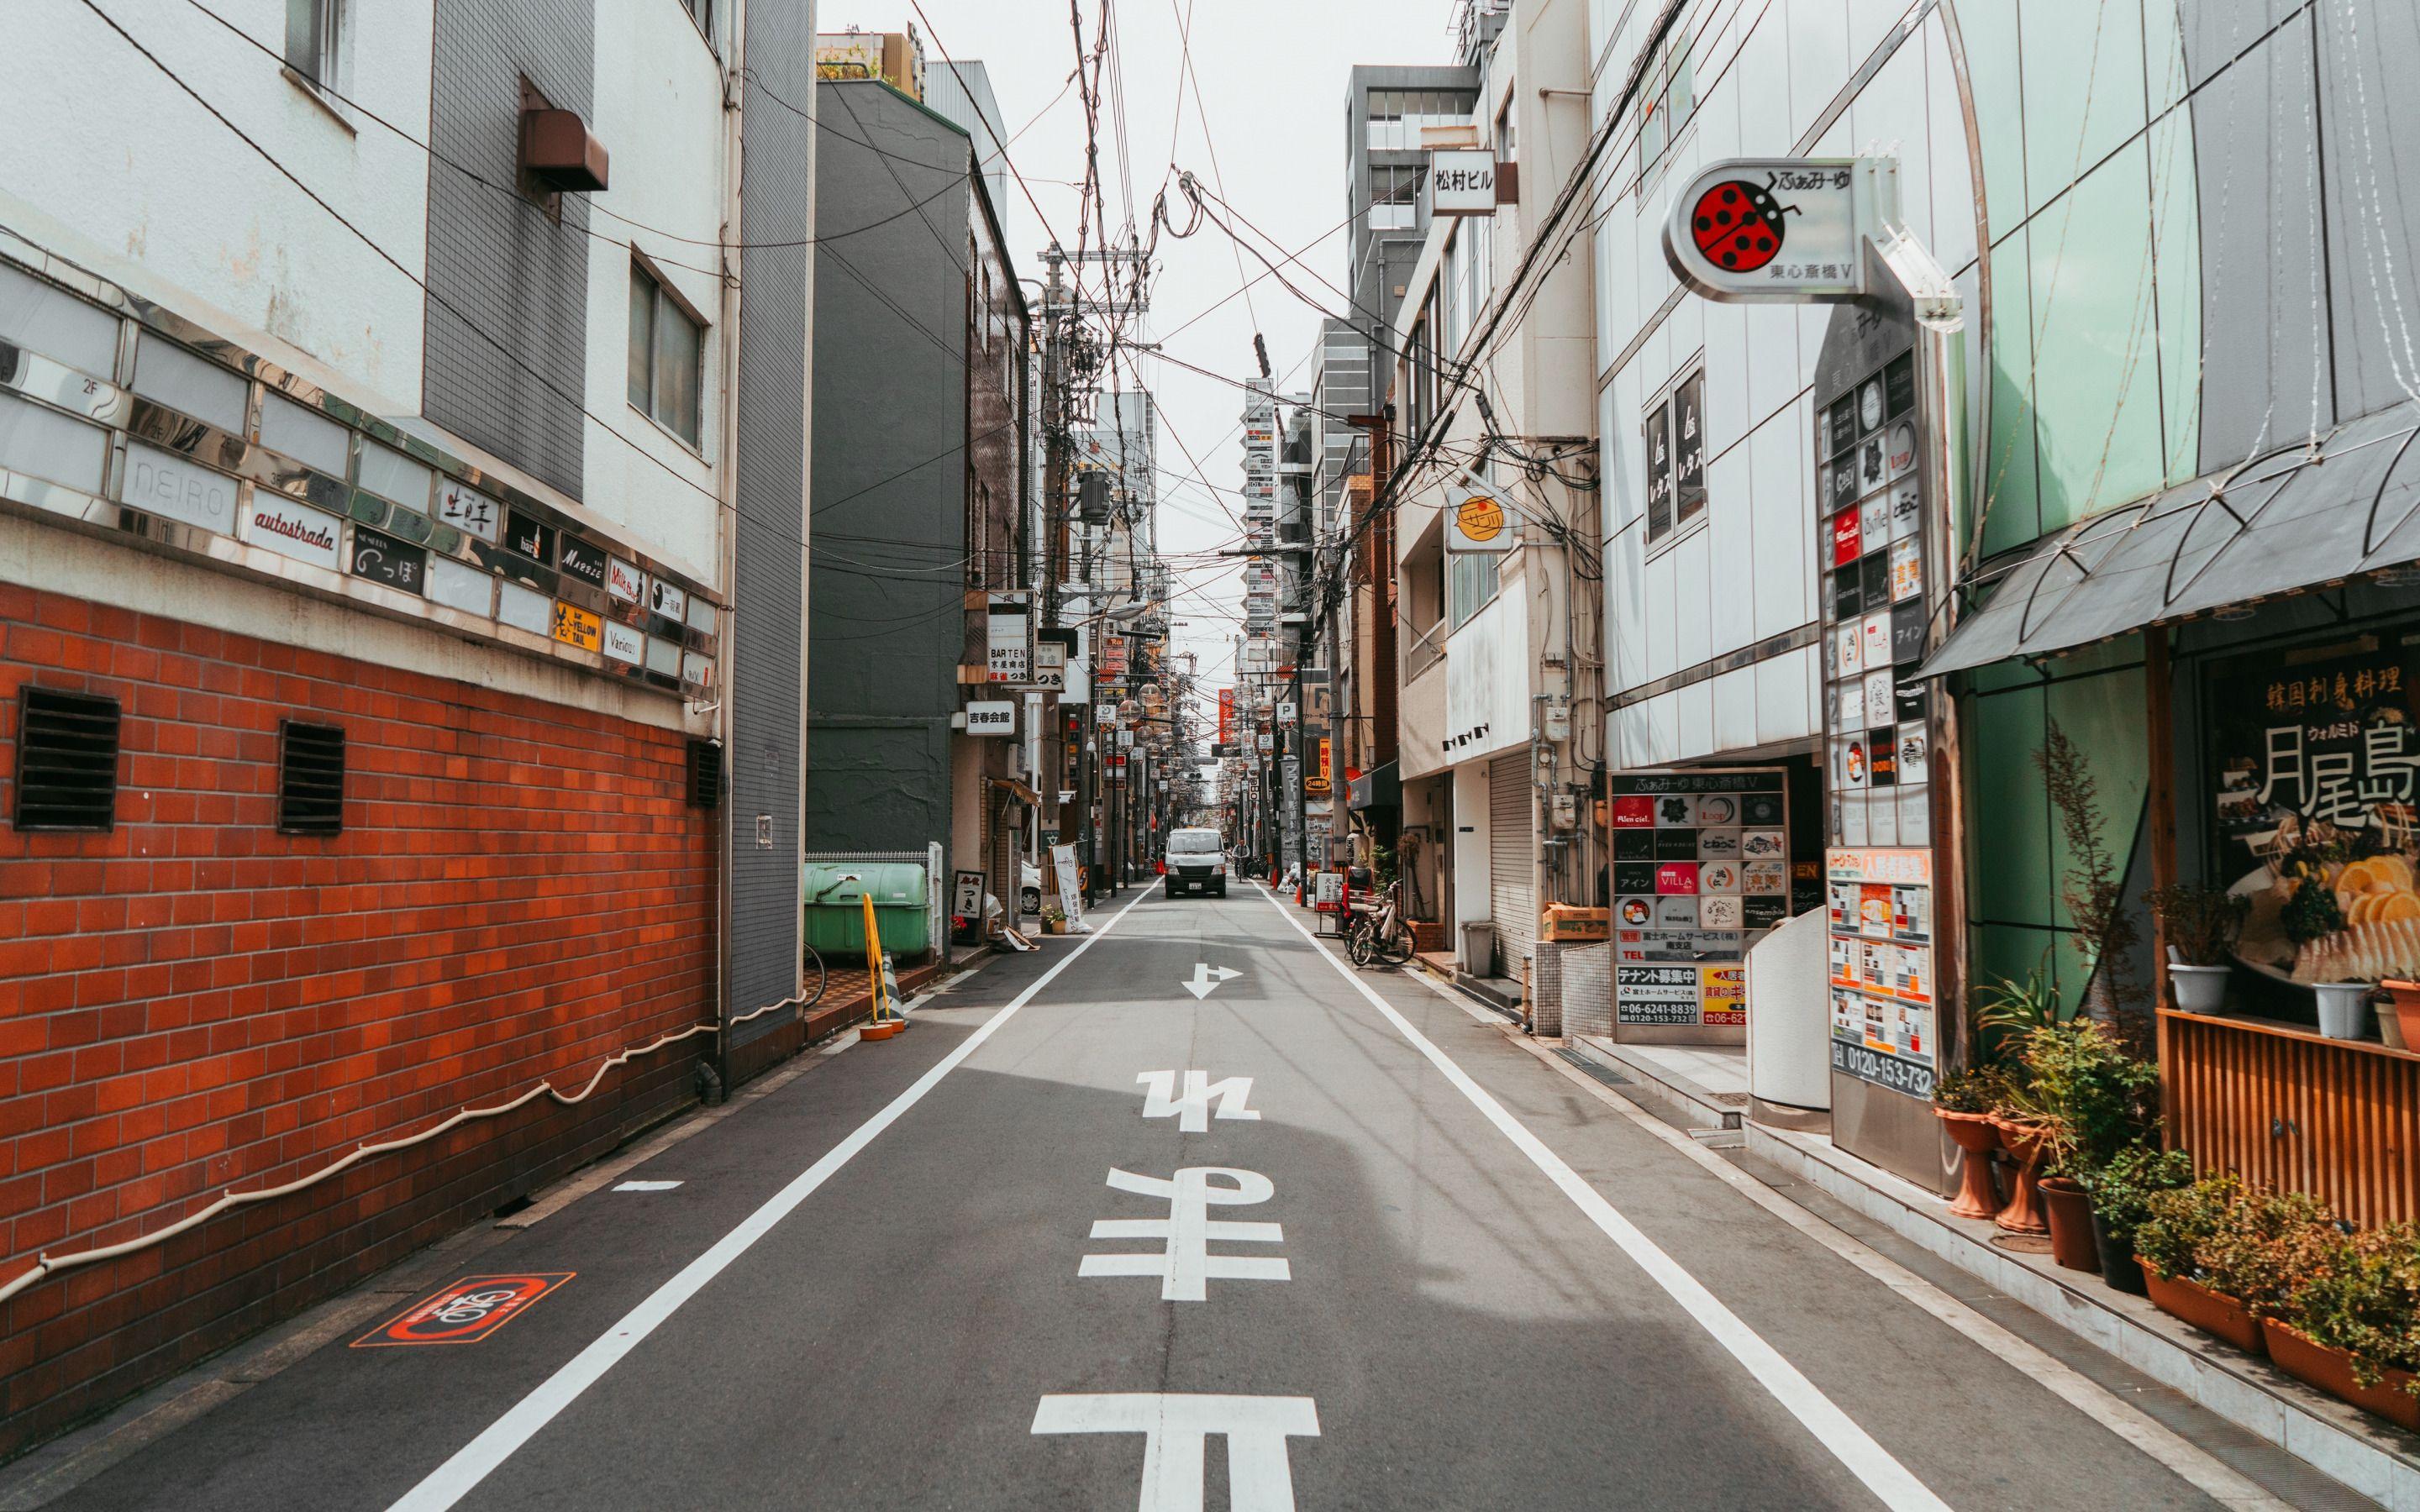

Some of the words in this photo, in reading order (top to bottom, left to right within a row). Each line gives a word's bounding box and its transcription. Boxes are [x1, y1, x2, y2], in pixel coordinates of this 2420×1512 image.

[1436, 170, 1493, 192] 松村ビル
[84, 379, 97, 395] 2F
[150, 426, 163, 439] 2F
[1679, 447, 1702, 480] レタス
[1650, 472, 1671, 503] レタス
[255, 511, 334, 551] autostrada
[573, 619, 597, 637] YELLOW
[572, 633, 586, 646] TAIL
[610, 630, 637, 655] Various
[992, 649, 1006, 658] BAR
[1008, 649, 1025, 658] TEN
[1038, 673, 1061, 685] つき
[2266, 666, 2403, 711] 韓国刺身料理
[1282, 706, 1291, 715] P
[970, 711, 1010, 724] 吉春会館
[2257, 720, 2420, 827] 月尾島
[1620, 879, 1649, 887] アイン
[1661, 877, 1692, 885] VILLA
[1643, 932, 1739, 942] 富士ホームサービス(株)
[1623, 951, 1644, 959] TEL
[1618, 969, 1695, 984] テナント募集中
[1628, 1004, 1696, 1014] 06-6241-8839
[1715, 1013, 1746, 1023] 06-62
[1848, 1047, 1932, 1093] 0120-153-732
